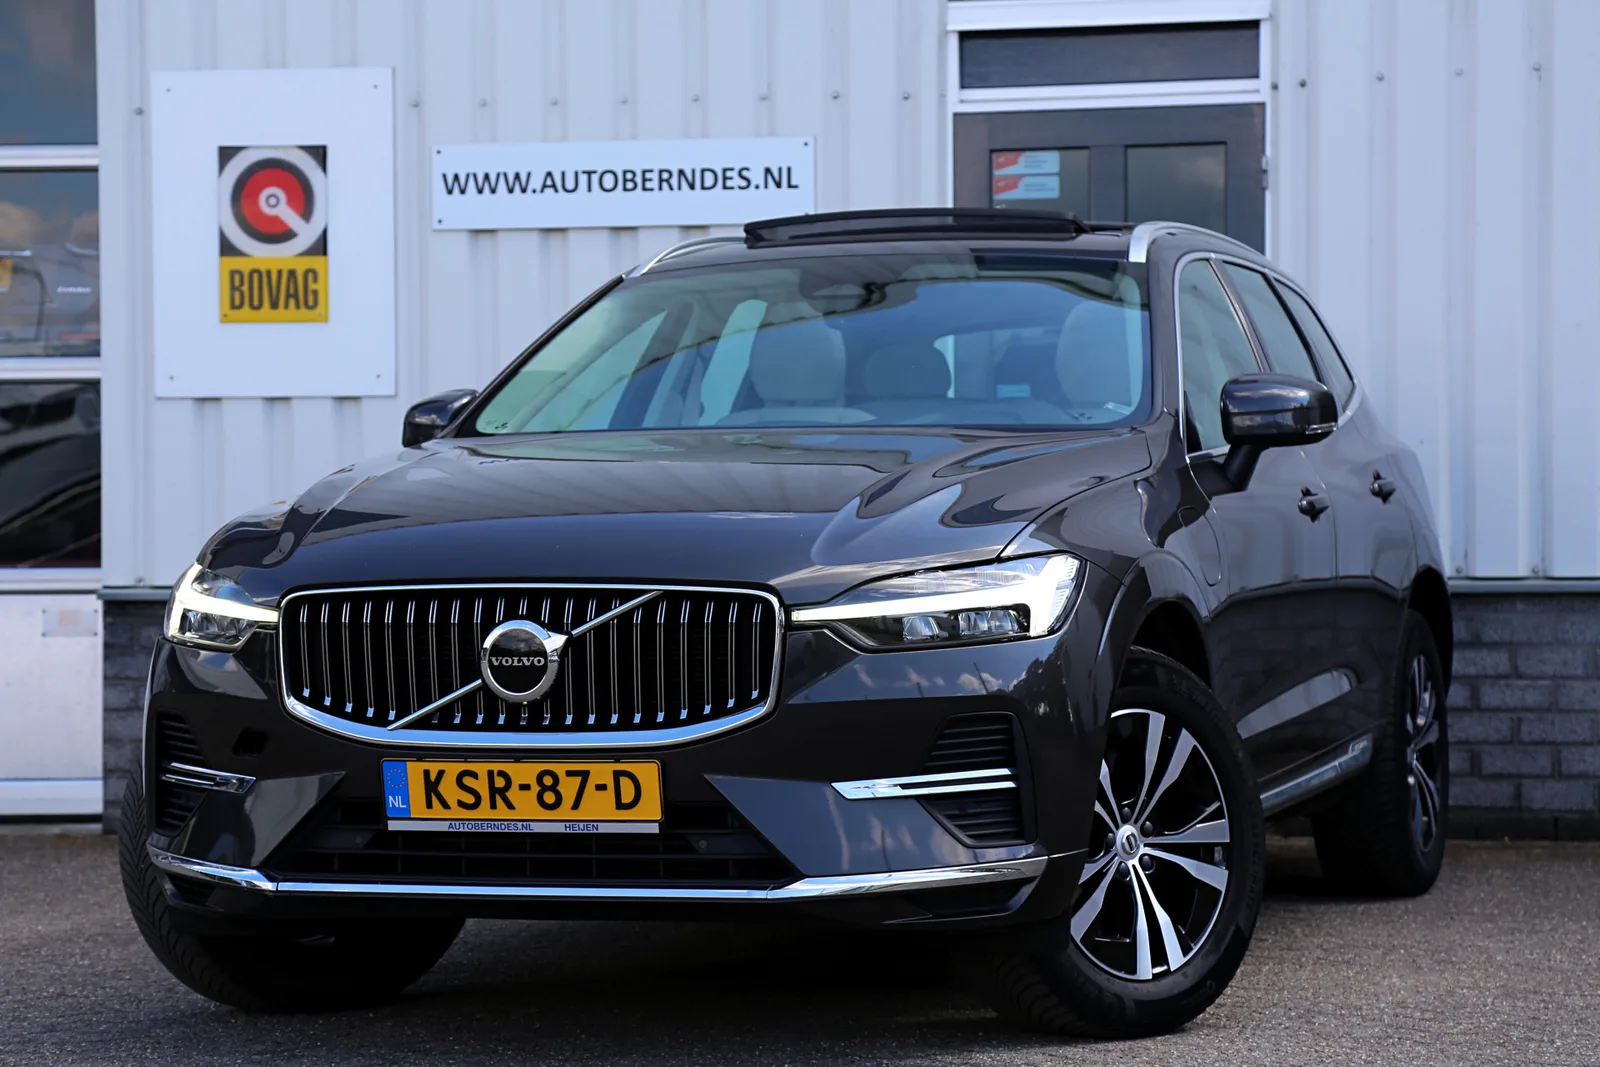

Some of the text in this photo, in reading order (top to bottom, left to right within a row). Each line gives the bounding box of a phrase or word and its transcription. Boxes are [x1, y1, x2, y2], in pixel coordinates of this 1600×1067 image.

[442, 166, 799, 195] WWW.AUTOBERNDES.NL
[229, 268, 319, 311] BOVAG
[490, 656, 545, 666] VOLVO
[423, 769, 642, 810] KSR-87-D
[389, 796, 406, 808] NL
[447, 822, 599, 832] AUTOBERNDES.NL HEIJEN
